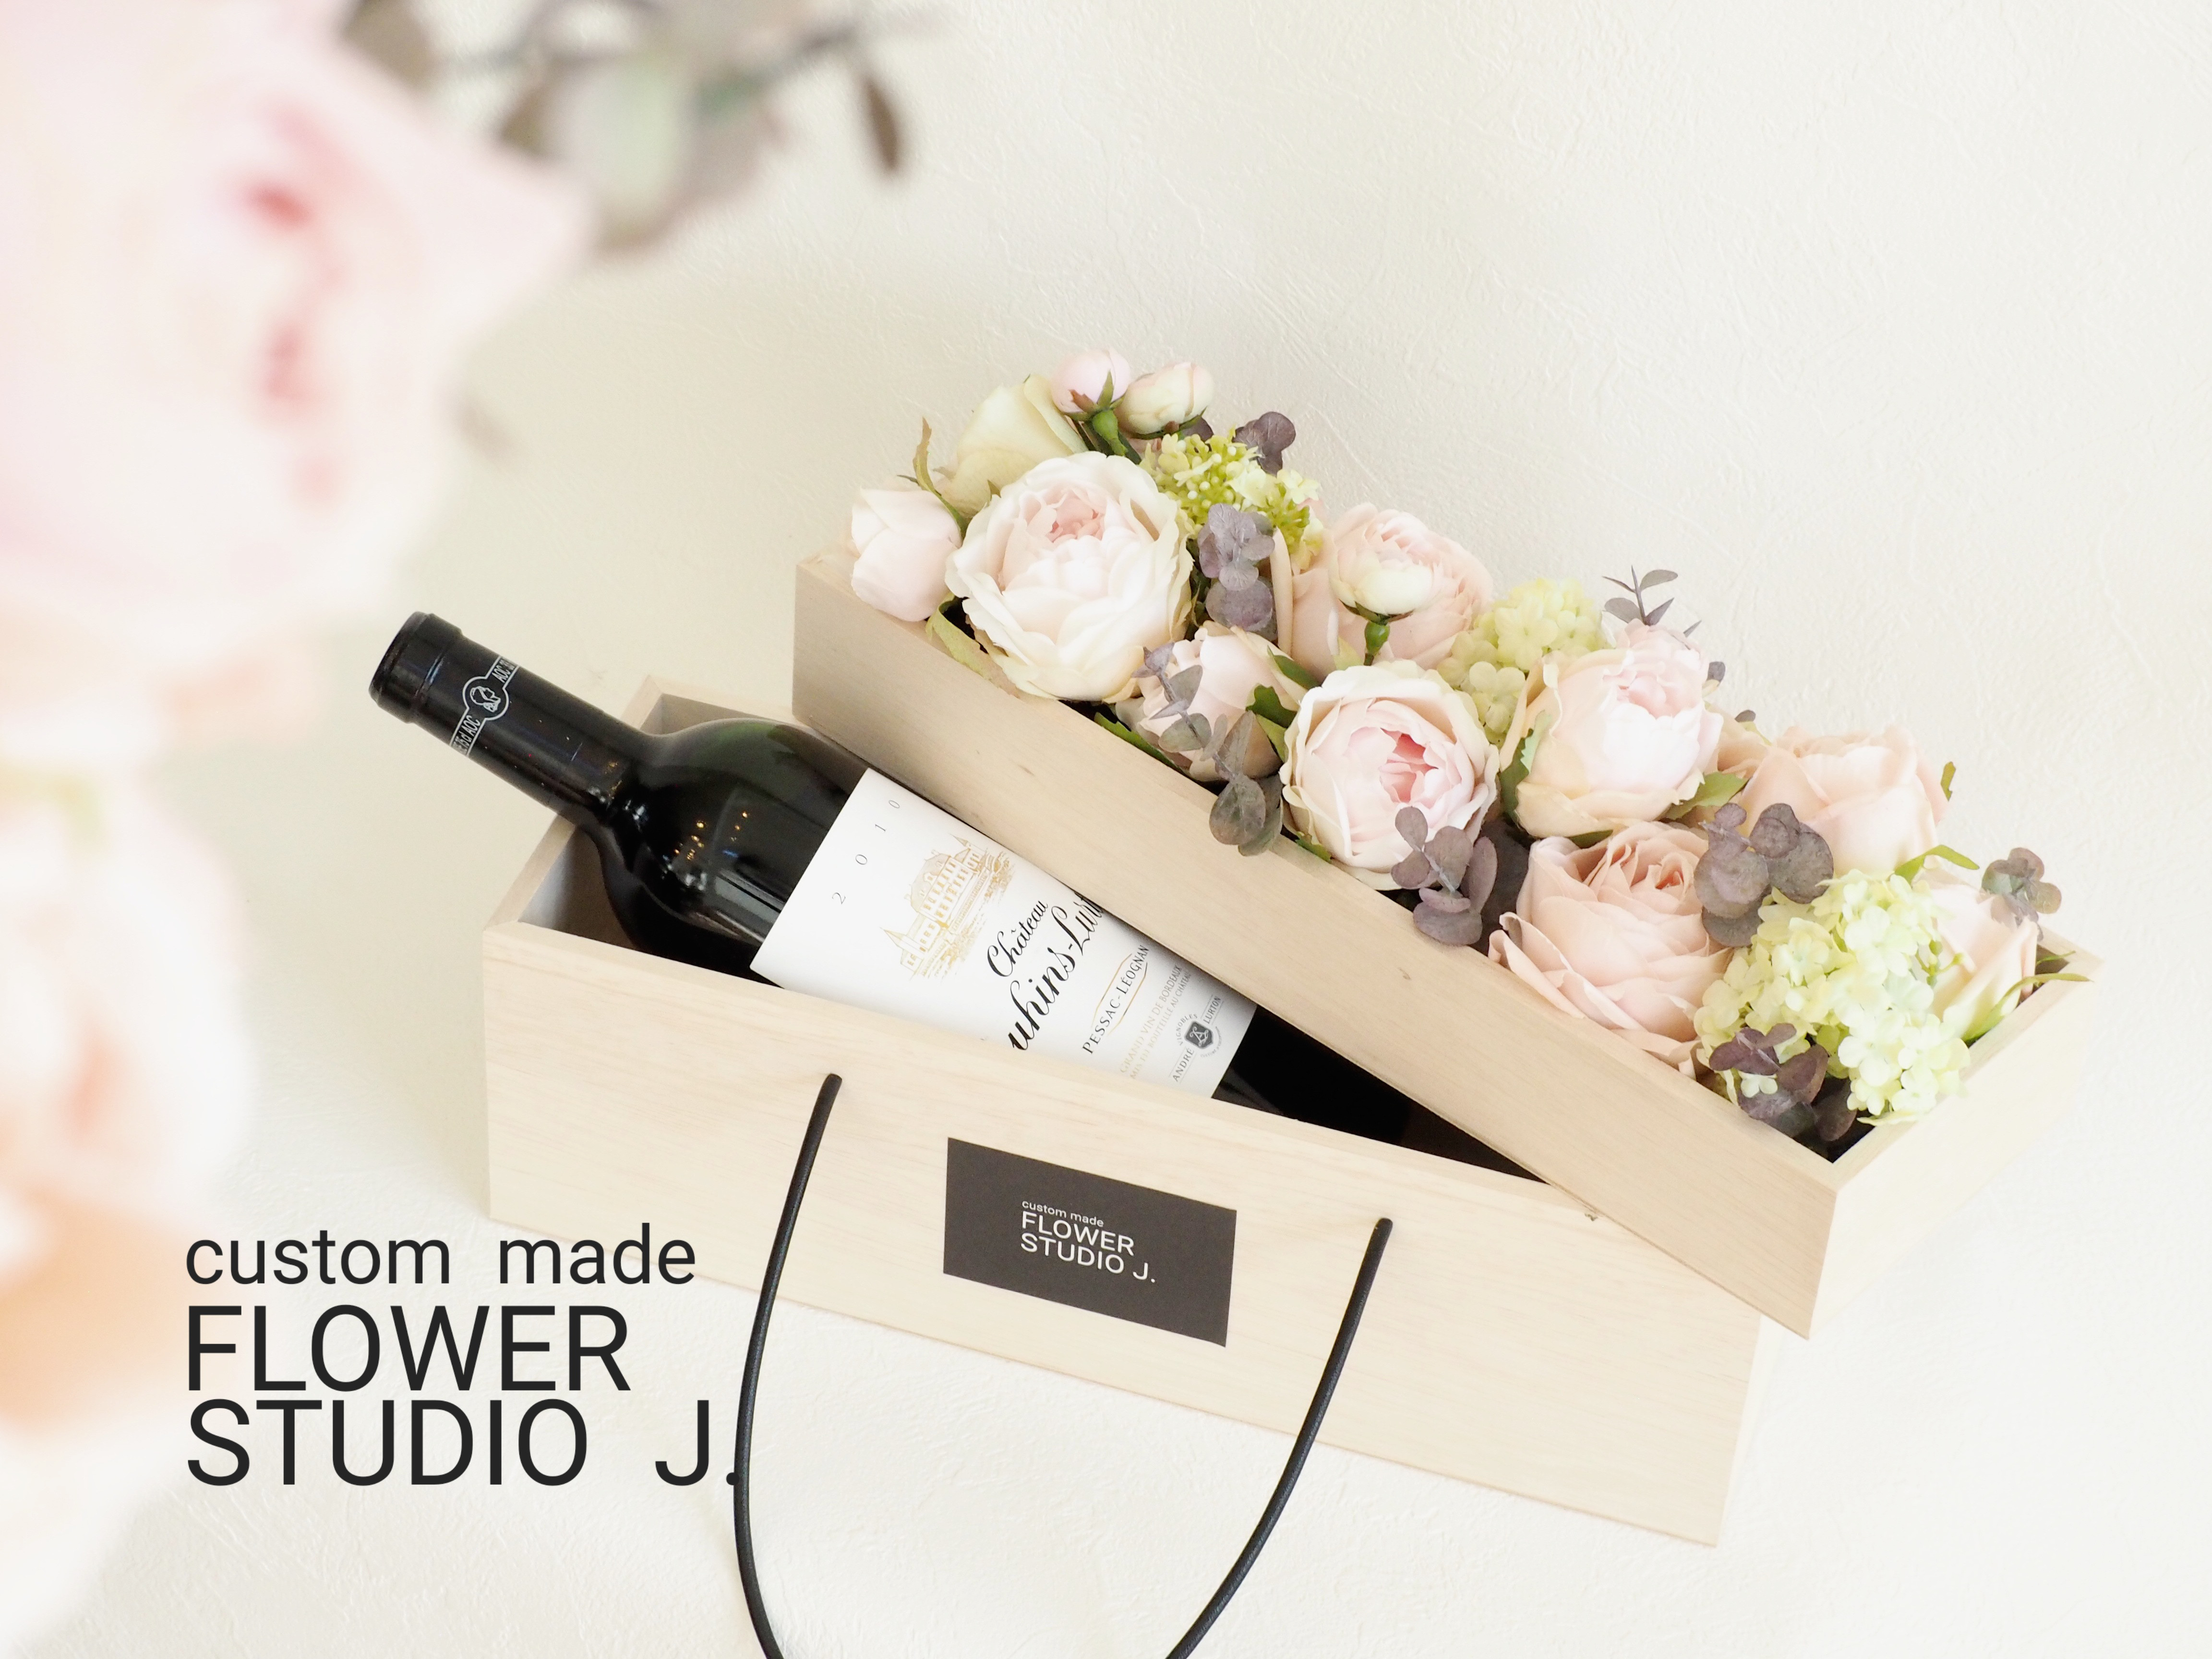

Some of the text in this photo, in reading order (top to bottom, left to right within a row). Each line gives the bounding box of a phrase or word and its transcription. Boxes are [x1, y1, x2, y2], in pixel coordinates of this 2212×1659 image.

[460, 715, 481, 737] AOC
[492, 664, 511, 684] AOC
[987, 901, 1048, 977] Château
[1082, 945, 1149, 1055] PESSAC-LÉOGNAN
[1141, 1015, 1156, 1034] VIN
[1152, 1002, 1164, 1015] DE
[1158, 964, 1182, 1003] BORDEAUX
[1170, 996, 1179, 1008] AU
[1176, 1013, 1198, 1046] VIGNOBLES
[1172, 1047, 1194, 1082] ANDRÉ
[1203, 995, 1221, 1024] LURTON
[1022, 1201, 1104, 1227] custom made
[1022, 1211, 1134, 1256] FLOWER
[1021, 1232, 1156, 1284] STUDIO J.
